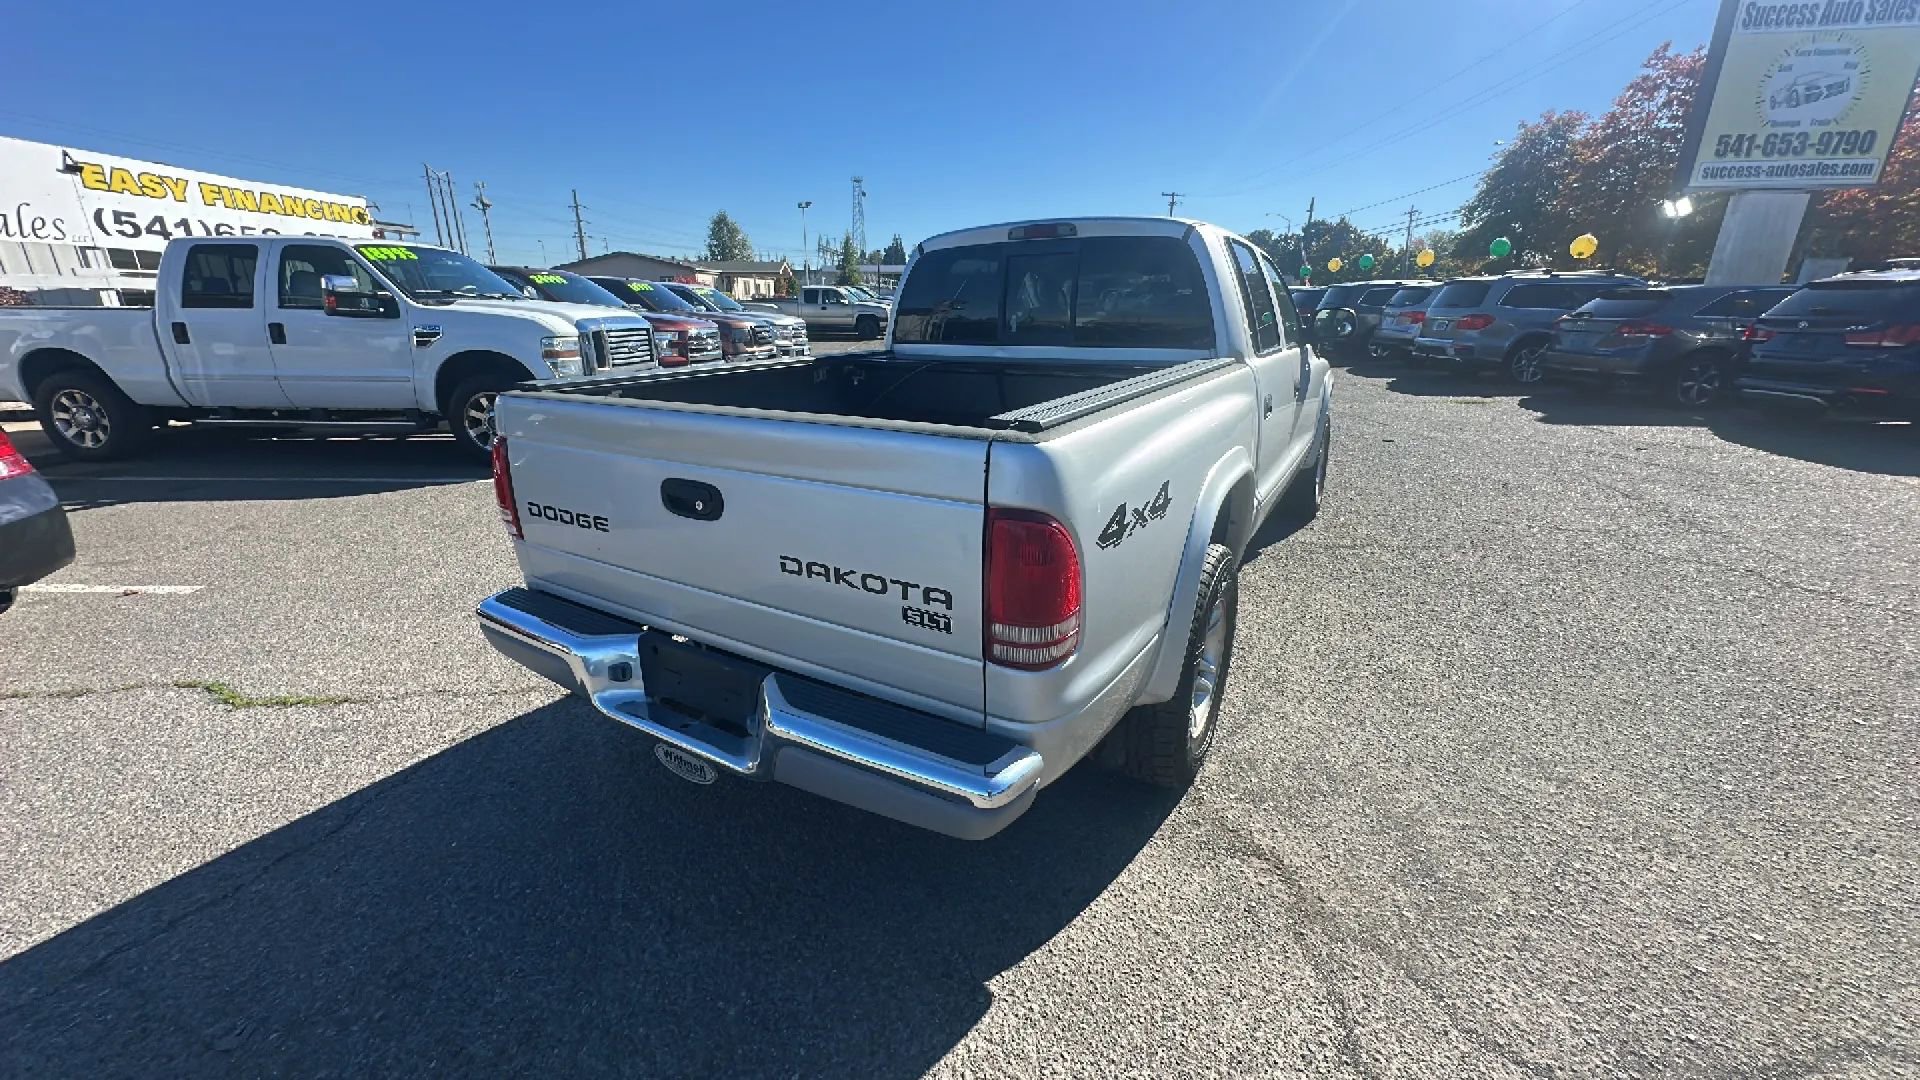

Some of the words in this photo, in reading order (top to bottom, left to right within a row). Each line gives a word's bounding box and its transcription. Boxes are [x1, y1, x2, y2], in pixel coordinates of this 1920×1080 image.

[1742, 3, 1820, 30] Success
[1819, 0, 1865, 24] Auto
[1865, 0, 1919, 23] Sales
[1714, 129, 1878, 158] 541-653-9790
[1702, 161, 1874, 180] success-autosales.com
[80, 161, 188, 202] EASY
[198, 181, 370, 225] FINANCING
[527, 501, 610, 533] DODGE
[1096, 480, 1173, 551] 4x4
[779, 555, 953, 611] DAKOTA
[902, 606, 953, 634] SLT
